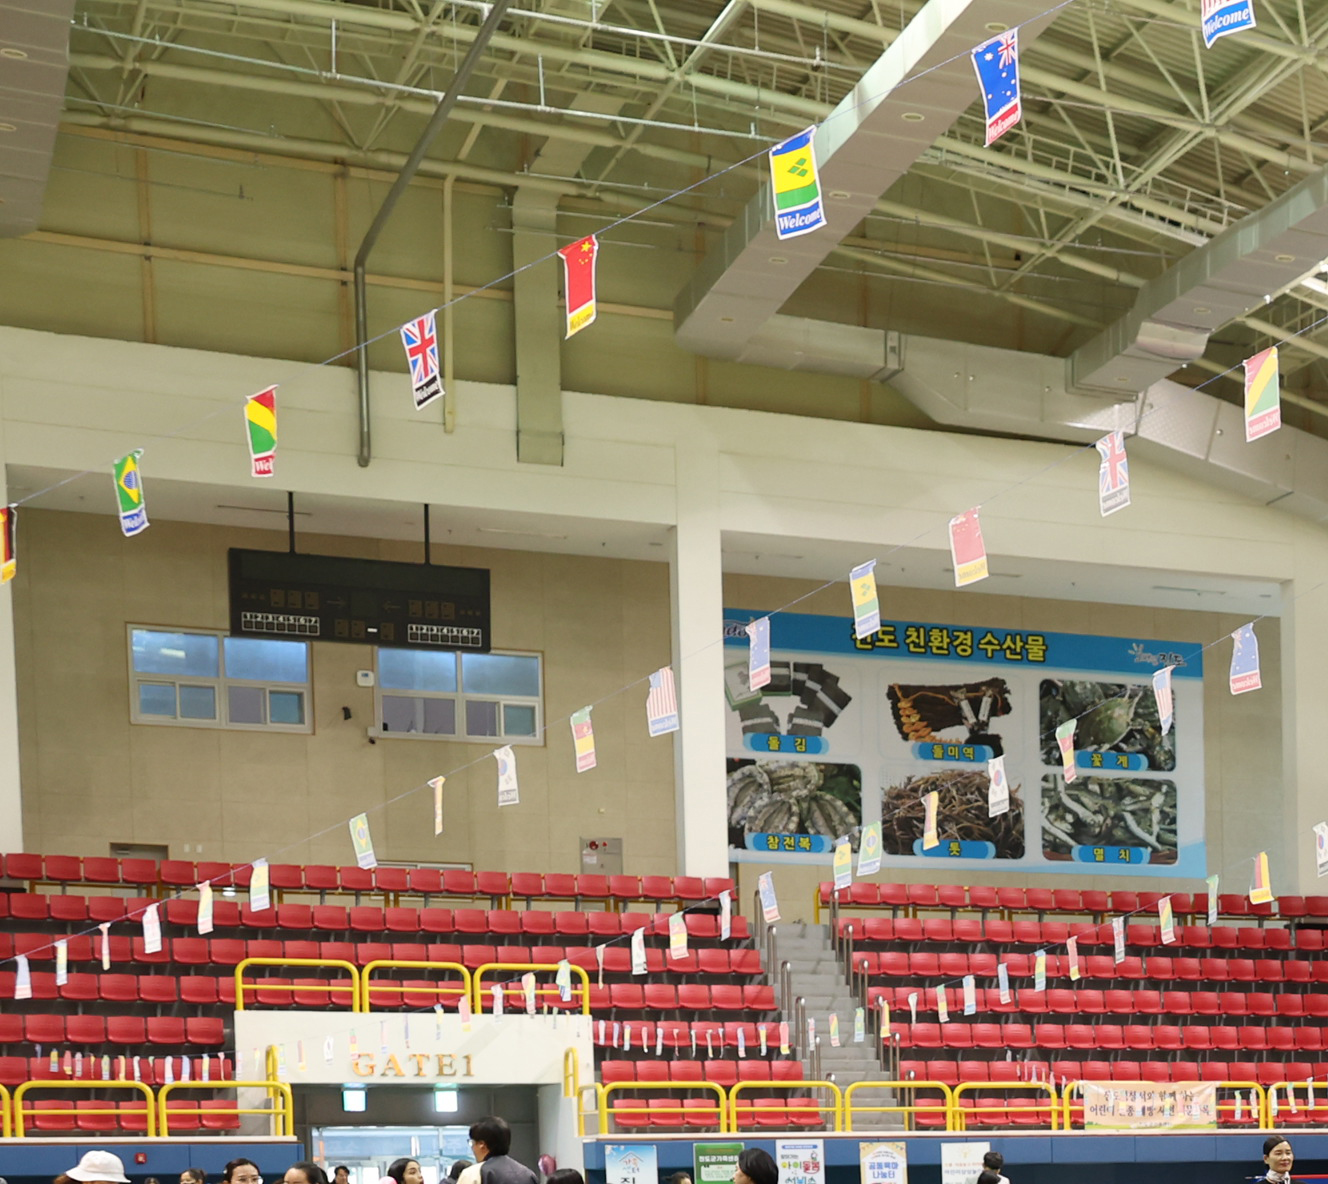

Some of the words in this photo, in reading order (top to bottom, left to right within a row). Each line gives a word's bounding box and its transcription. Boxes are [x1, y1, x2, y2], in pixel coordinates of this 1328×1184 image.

[1205, 9, 1251, 35] Welcome
[987, 110, 1021, 138] Welcome
[779, 208, 821, 230] Welcome
[904, 627, 974, 657] 친환경
[978, 632, 1048, 662] 수산물
[766, 834, 812, 851] 참전복
[352, 1053, 475, 1078] GATE1
